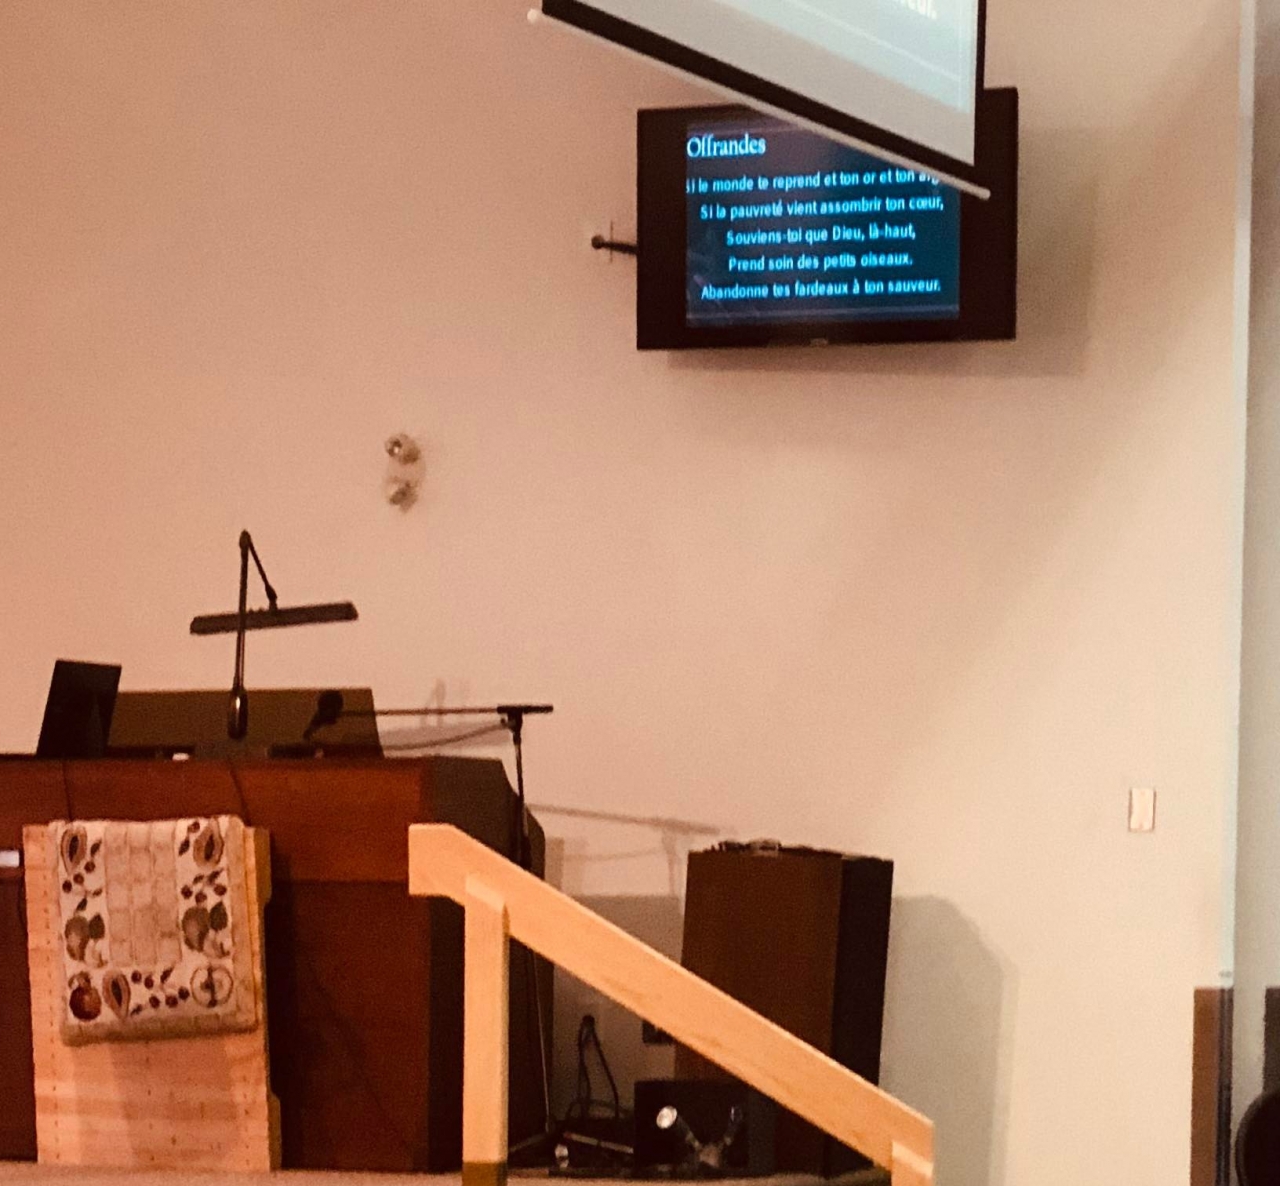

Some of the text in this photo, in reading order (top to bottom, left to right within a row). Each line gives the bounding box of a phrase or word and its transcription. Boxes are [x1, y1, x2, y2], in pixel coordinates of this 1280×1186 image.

[686, 132, 766, 158] Offrandes
[713, 175, 754, 191] monde
[773, 171, 820, 192] reprend
[824, 171, 837, 186] et
[840, 171, 859, 185] ton
[863, 171, 876, 184] or
[880, 168, 892, 183] et
[895, 168, 915, 182] ton
[701, 204, 713, 219] Si
[730, 199, 783, 221] pauvreté
[787, 199, 818, 215] vient
[820, 196, 881, 214] assombrir
[885, 197, 905, 211] ton
[805, 228, 828, 246] que
[832, 224, 865, 241] Dieu,
[729, 255, 765, 271] Prend
[769, 254, 793, 270] soin
[797, 253, 819, 269] des
[823, 252, 856, 271] petits
[701, 282, 768, 299] Abandonne
[773, 282, 790, 297] tes
[795, 279, 848, 296] fardeaux
[864, 280, 884, 294] ton
